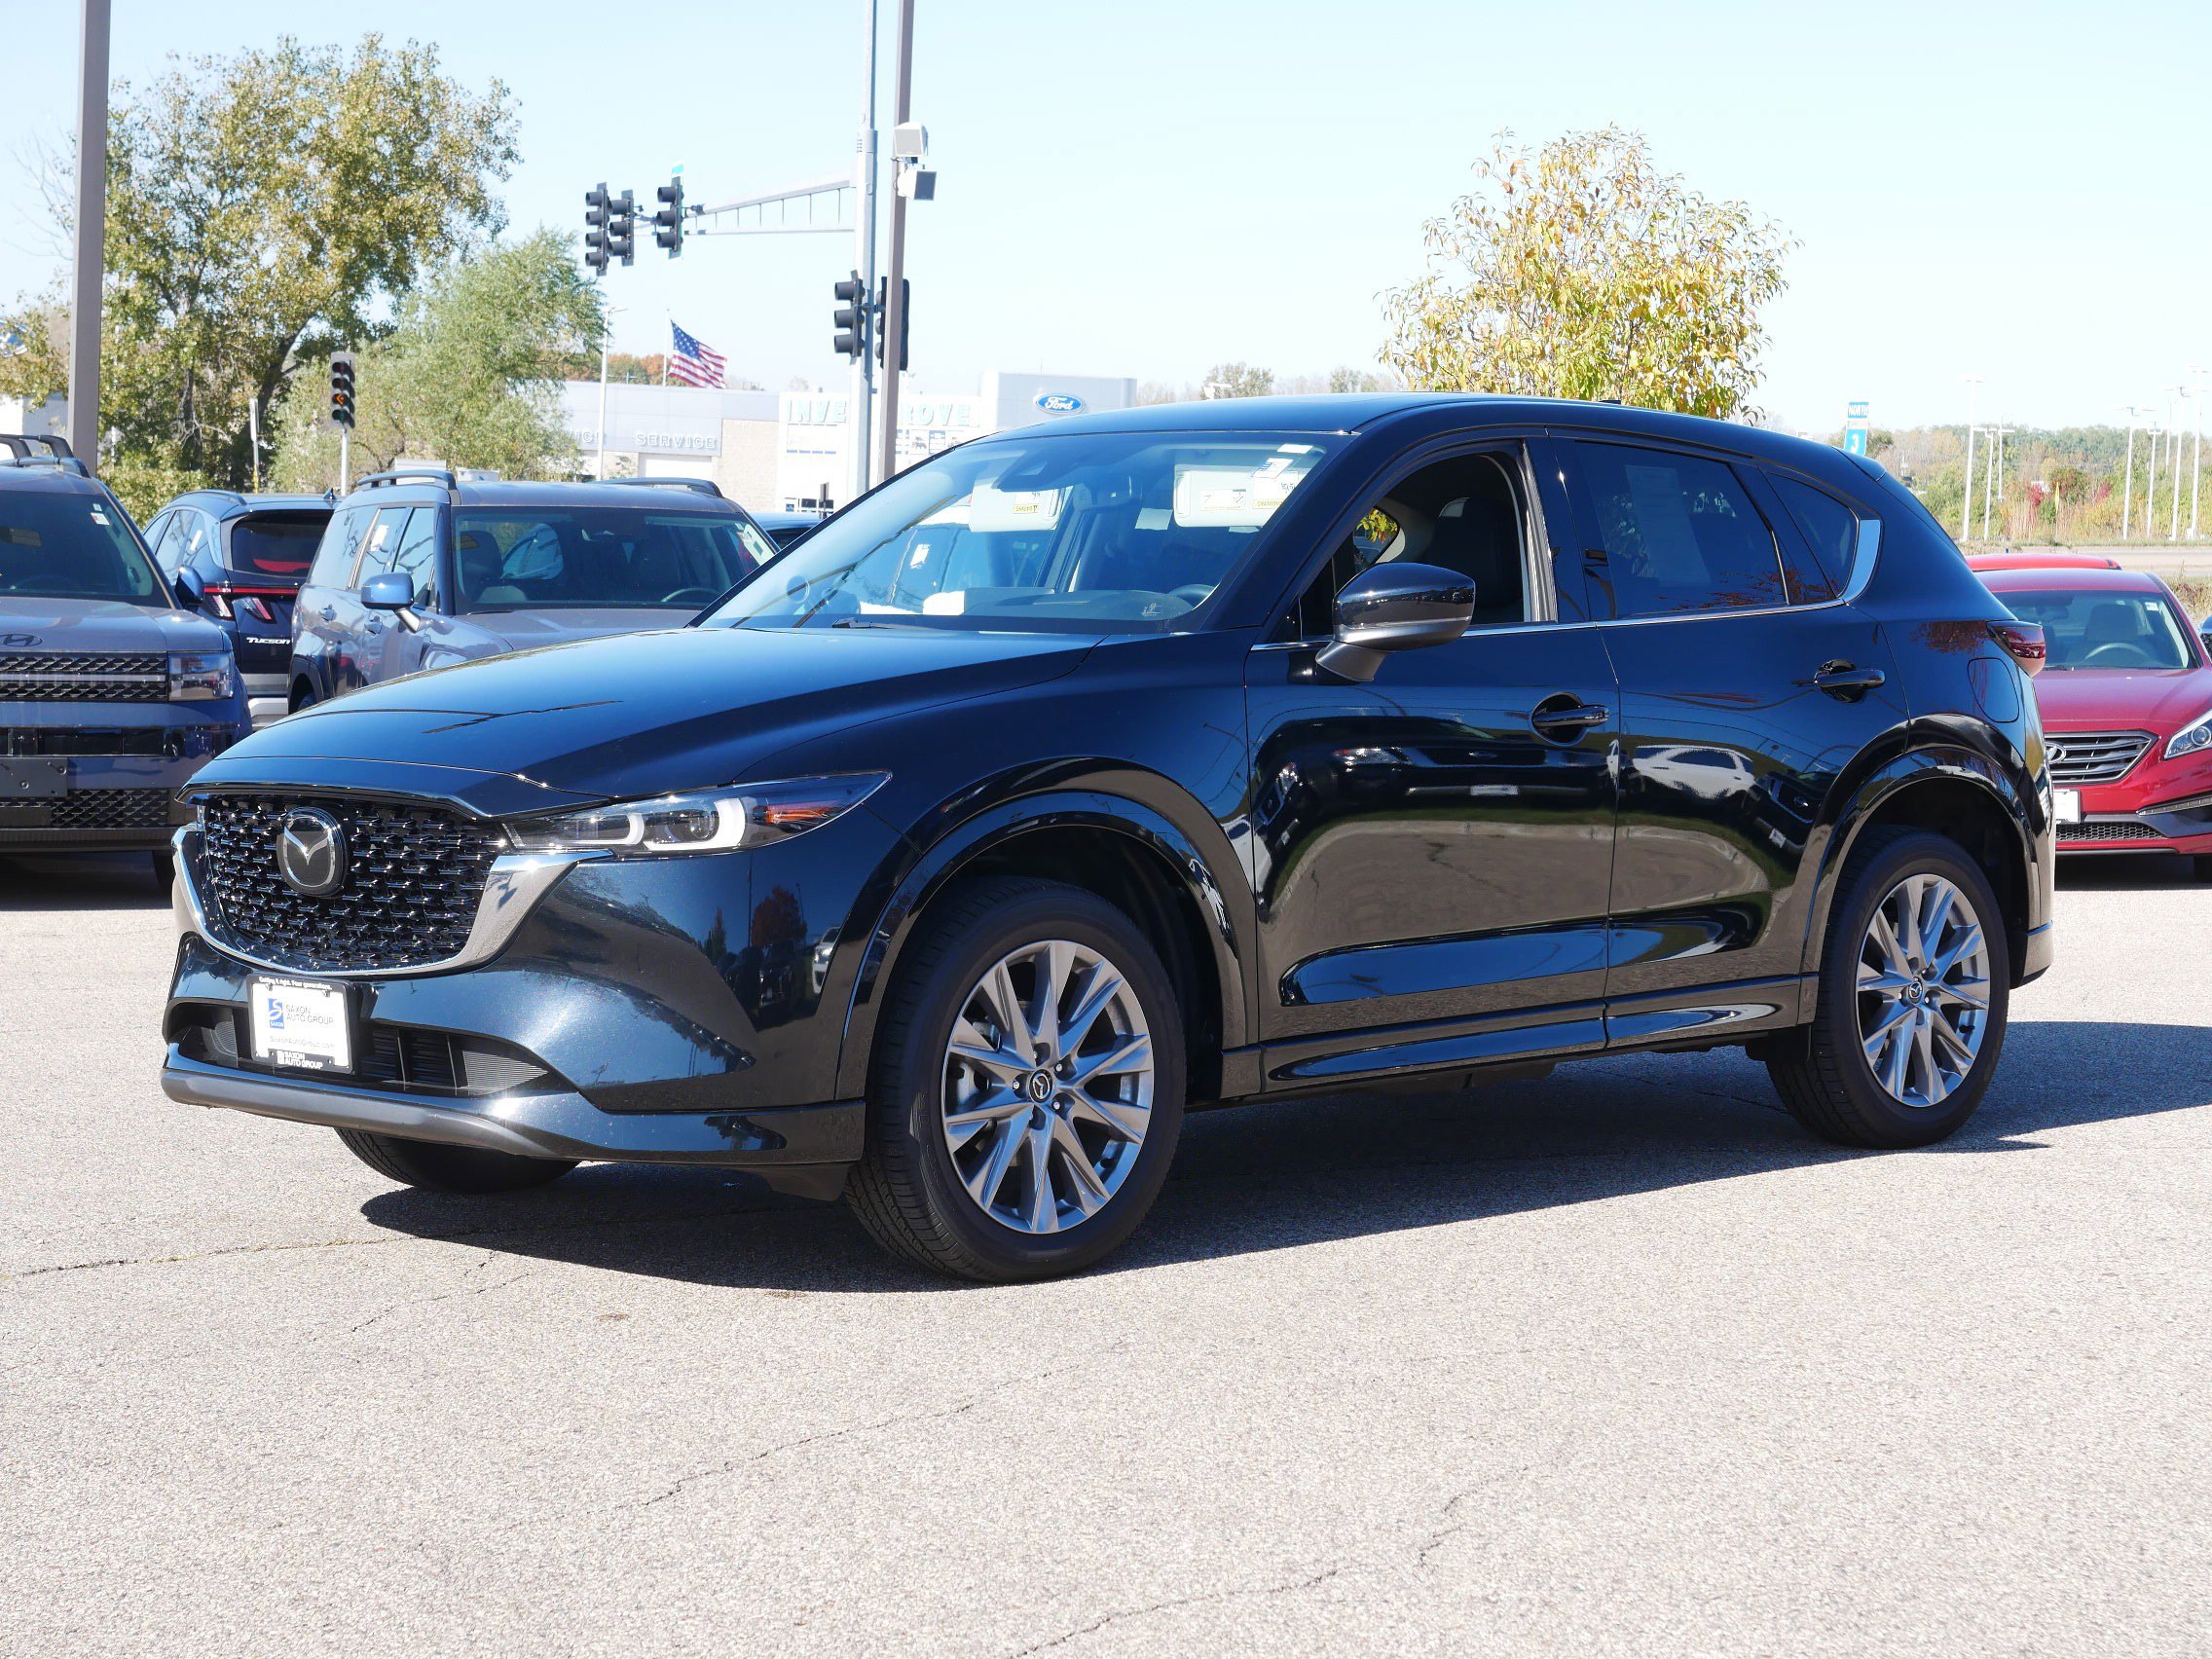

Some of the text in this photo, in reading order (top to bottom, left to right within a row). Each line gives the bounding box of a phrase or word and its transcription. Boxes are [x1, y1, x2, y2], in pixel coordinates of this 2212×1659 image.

[1045, 396, 1074, 410] Ford
[786, 399, 971, 426] INVE ROVE
[635, 433, 718, 449] SERVICE
[286, 1005, 311, 1014] SAXON
[286, 1013, 334, 1025] AUTO GROUP
[284, 1051, 306, 1060] SAXON
[301, 1060, 323, 1070] GROUP
